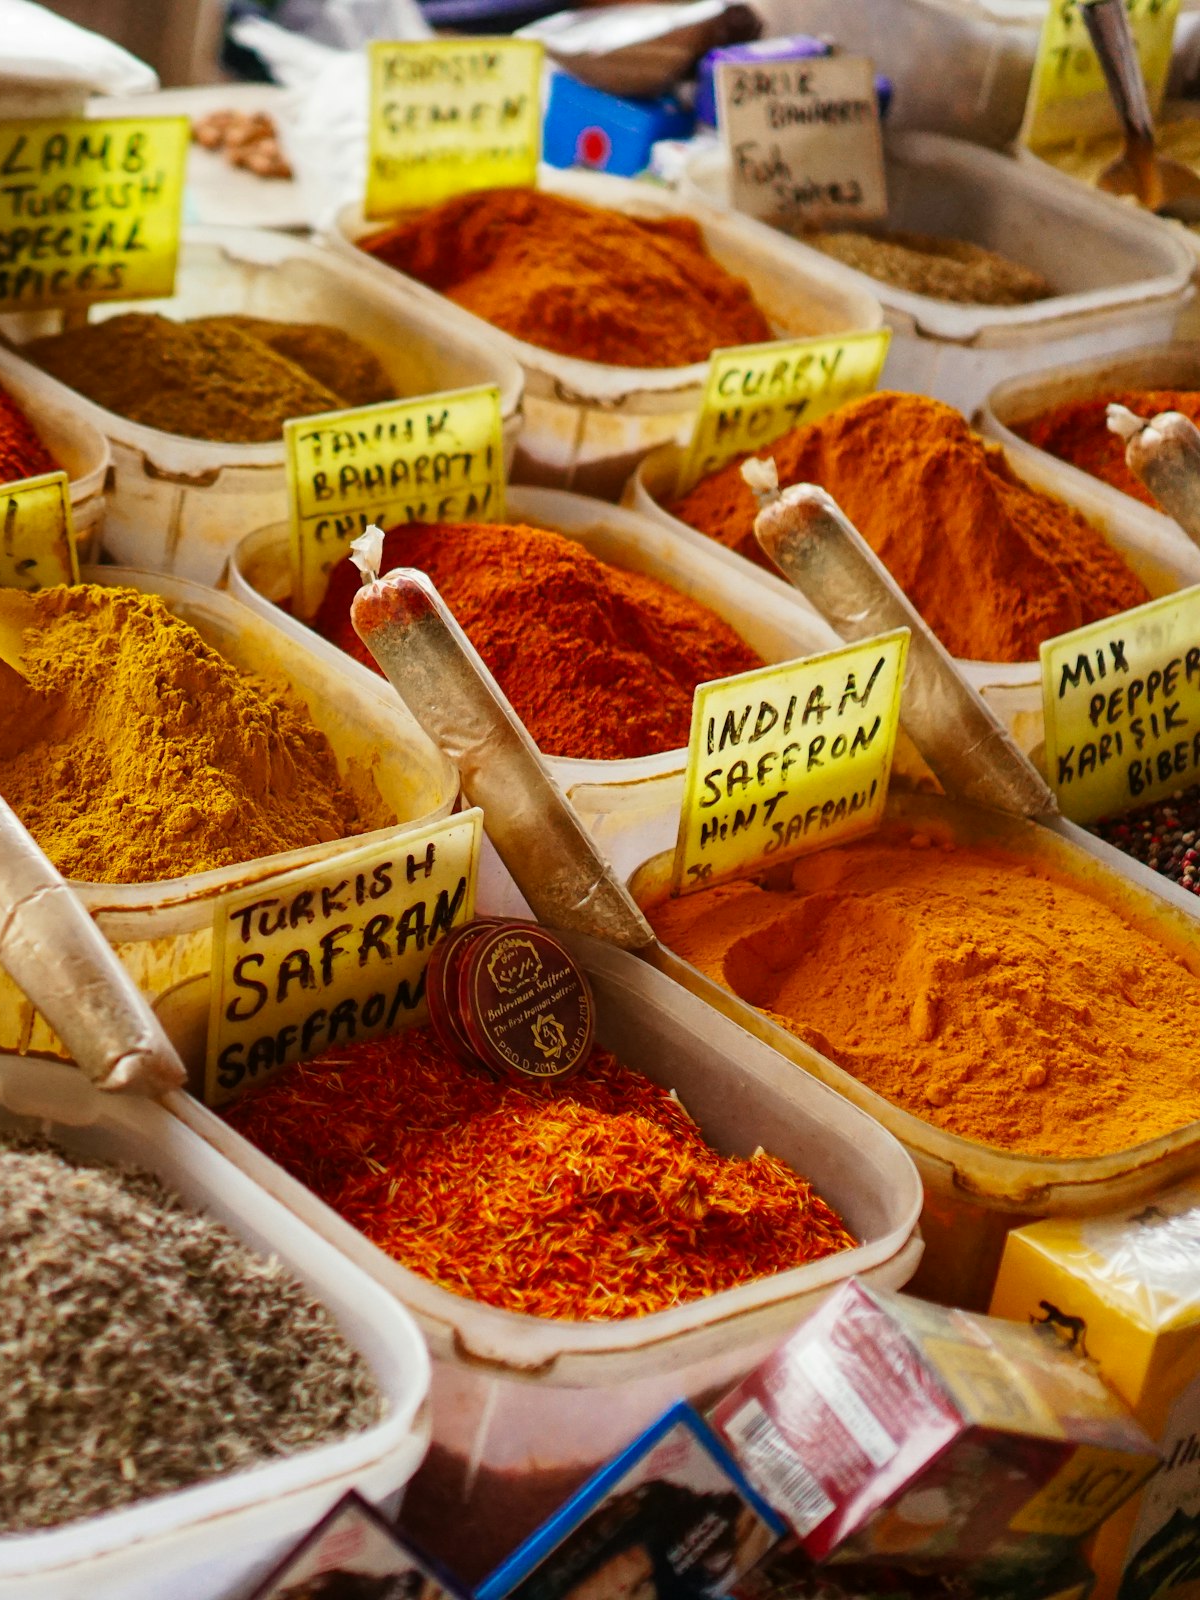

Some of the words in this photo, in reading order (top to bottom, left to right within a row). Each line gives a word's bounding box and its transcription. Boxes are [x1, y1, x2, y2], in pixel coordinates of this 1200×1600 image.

[2, 132, 146, 176] LAMB
[2, 171, 164, 217] TURKISH
[718, 348, 845, 398] CURRY
[312, 444, 495, 502] BAHARATI
[1059, 639, 1130, 698] MIX
[706, 656, 886, 756] INDIAN
[698, 715, 882, 810] SAFFRON
[230, 842, 437, 943] TURKISH
[224, 876, 468, 1023] SAFRAN
[216, 964, 428, 1090] SAFFRON
[534, 1061, 559, 1074] 2016
